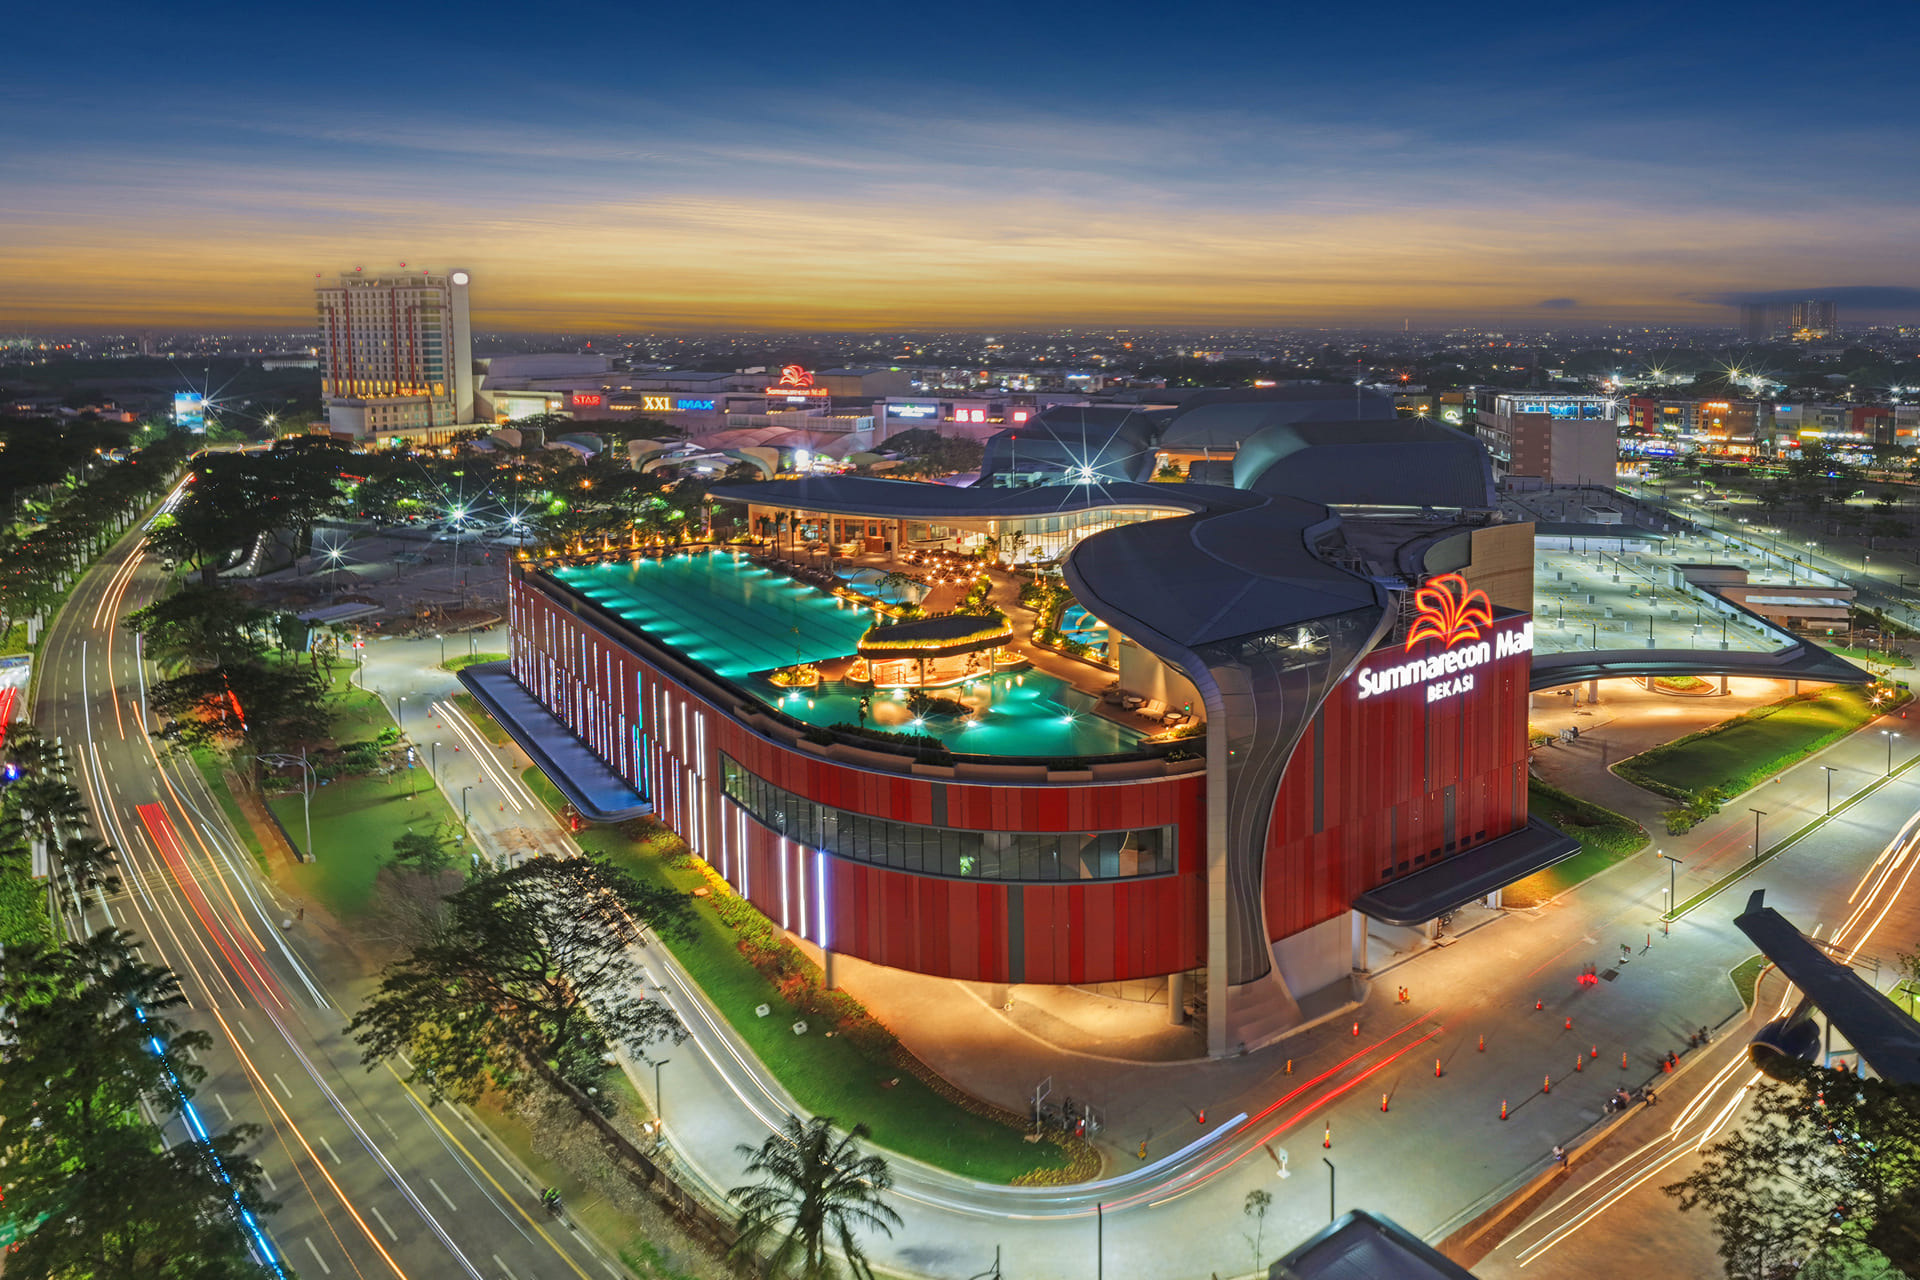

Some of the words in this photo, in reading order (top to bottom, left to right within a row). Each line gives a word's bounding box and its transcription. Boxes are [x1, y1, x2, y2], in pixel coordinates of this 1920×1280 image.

[573, 395, 601, 405] STAR
[643, 397, 670, 410] XXI
[677, 400, 713, 410] IMAX
[1358, 642, 1491, 700] Summarecon
[1496, 622, 1534, 660] Mall
[1427, 674, 1474, 703] BEKASI
